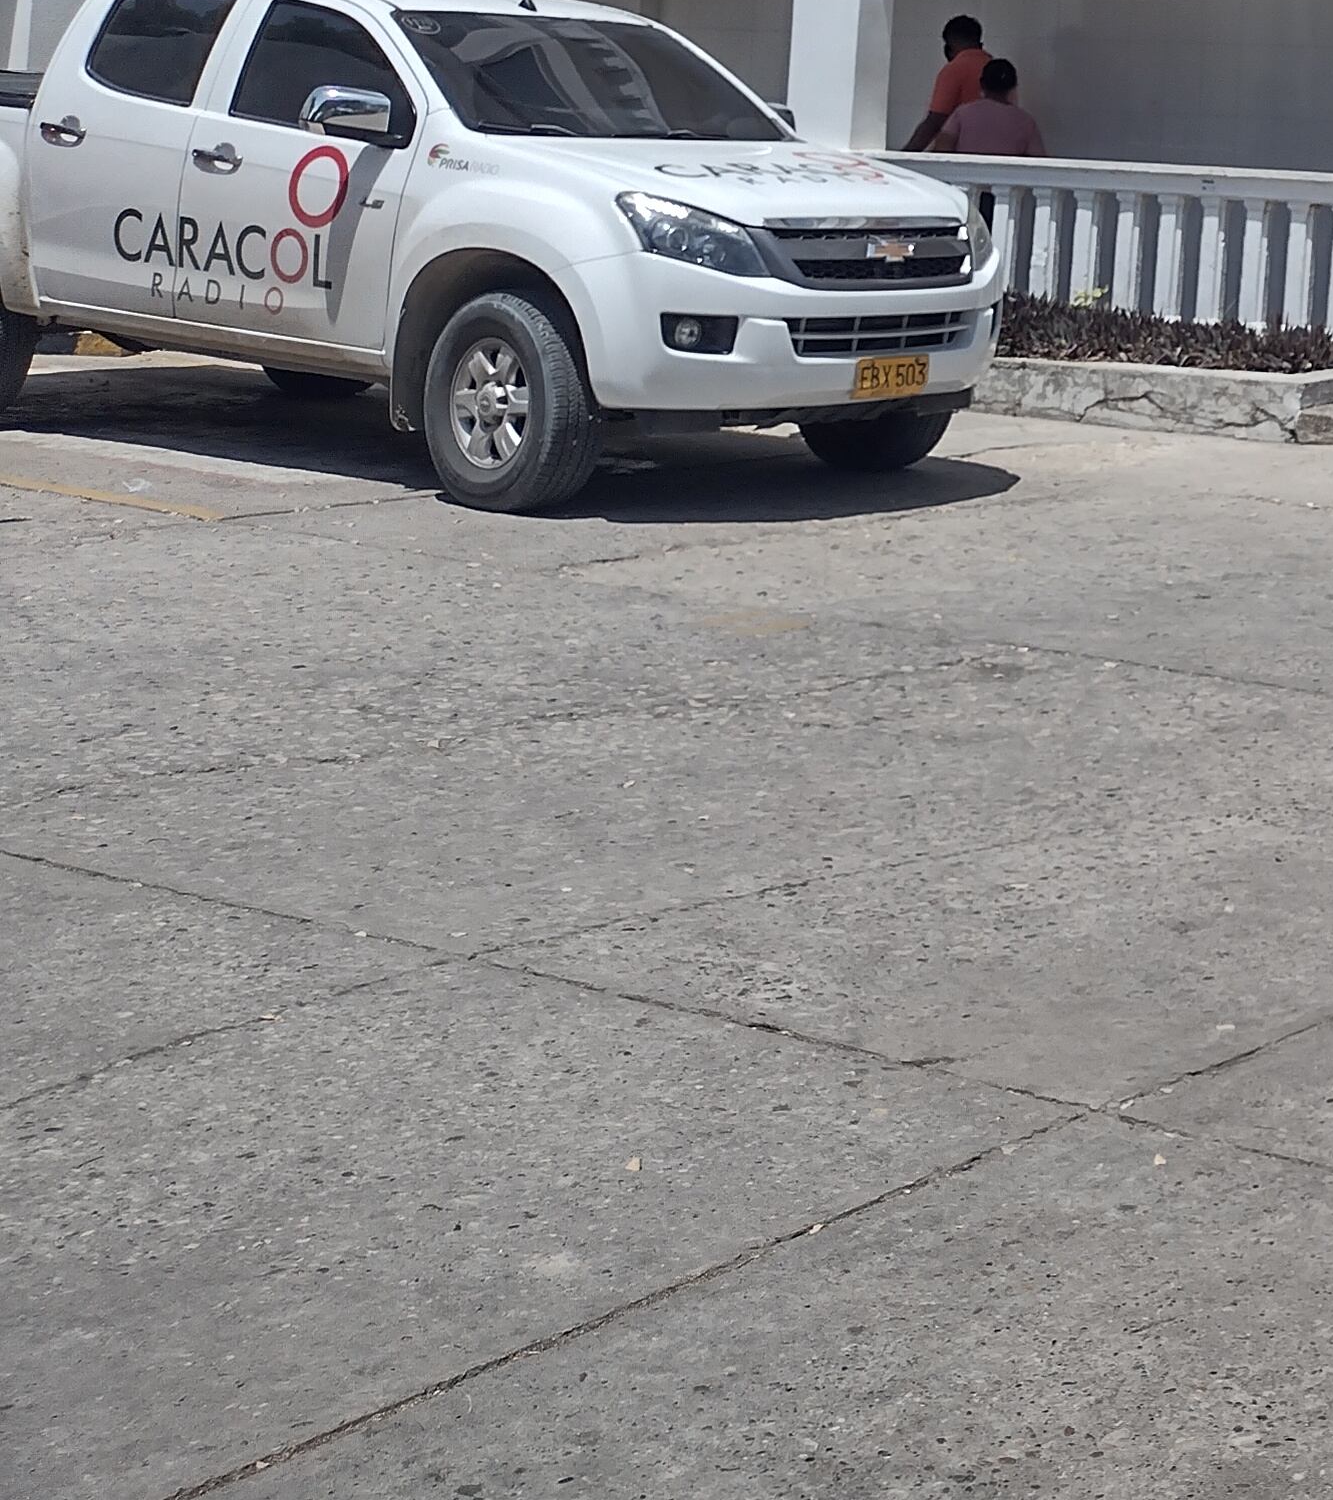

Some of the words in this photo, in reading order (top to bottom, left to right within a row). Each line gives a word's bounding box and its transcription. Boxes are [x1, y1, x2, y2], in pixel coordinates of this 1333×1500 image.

[438, 156, 469, 172] PRISA
[113, 207, 333, 290] CARACOL
[151, 272, 284, 316] RADIO
[860, 364, 893, 391] EBX
[895, 361, 927, 388] 503
